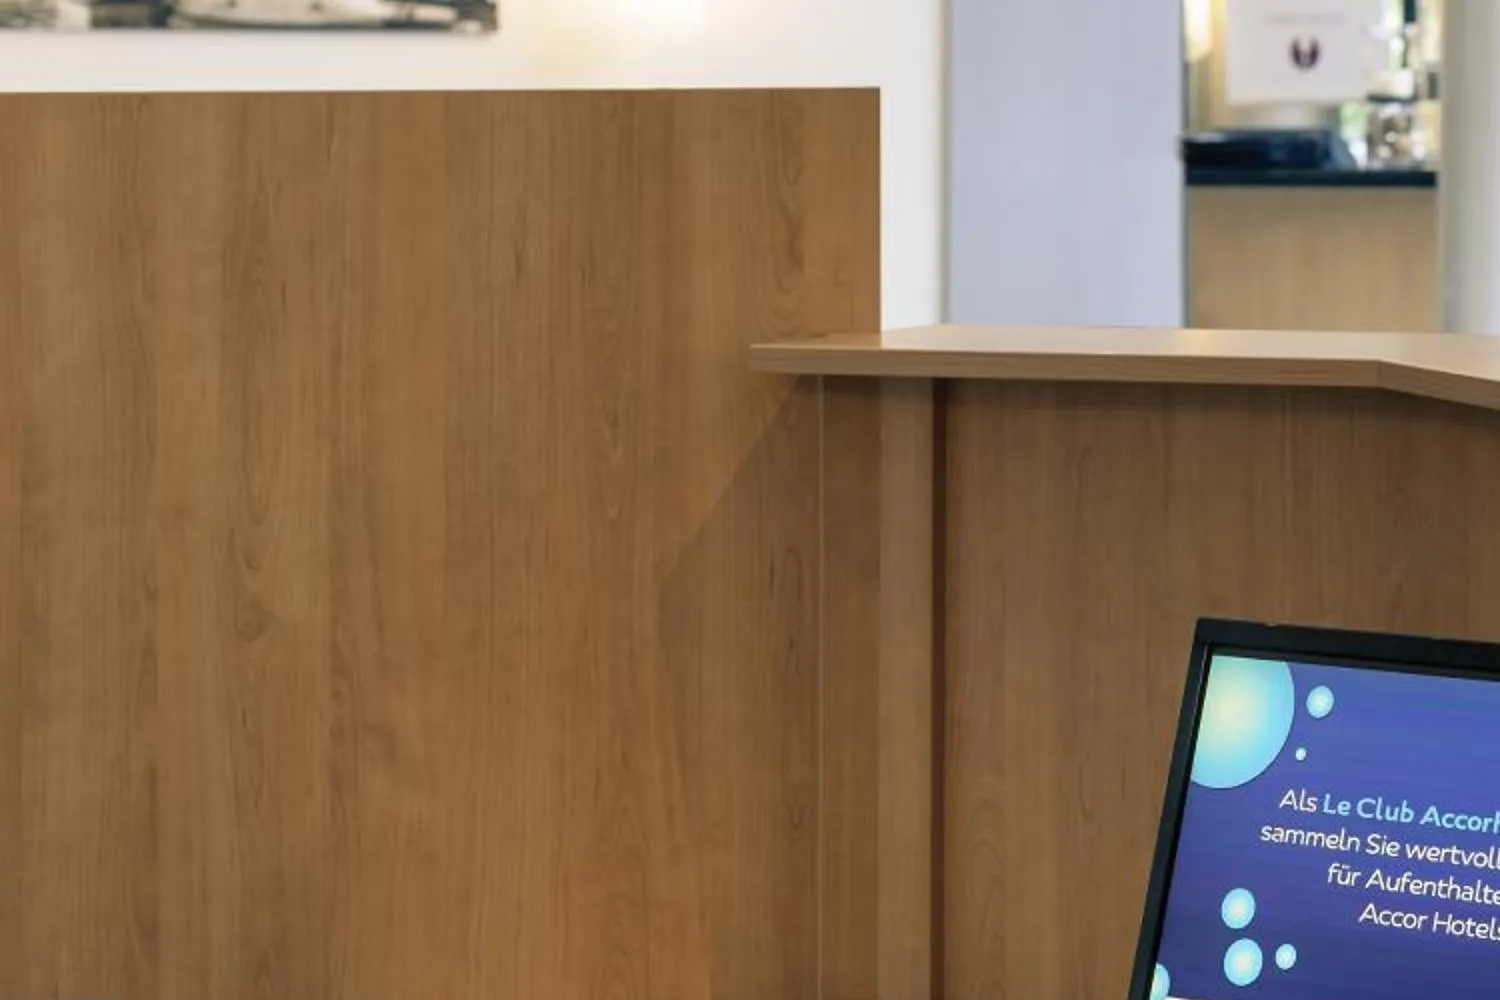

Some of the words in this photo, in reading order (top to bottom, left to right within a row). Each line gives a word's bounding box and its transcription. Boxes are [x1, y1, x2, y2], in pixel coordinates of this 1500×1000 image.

[1279, 788, 1318, 814] Als
[1322, 793, 1351, 816] Le
[1356, 796, 1415, 823] Club
[1260, 824, 1361, 853] sammeln
[1365, 833, 1400, 857] Sie
[1327, 862, 1362, 887] für
[1358, 902, 1429, 931] Accor
